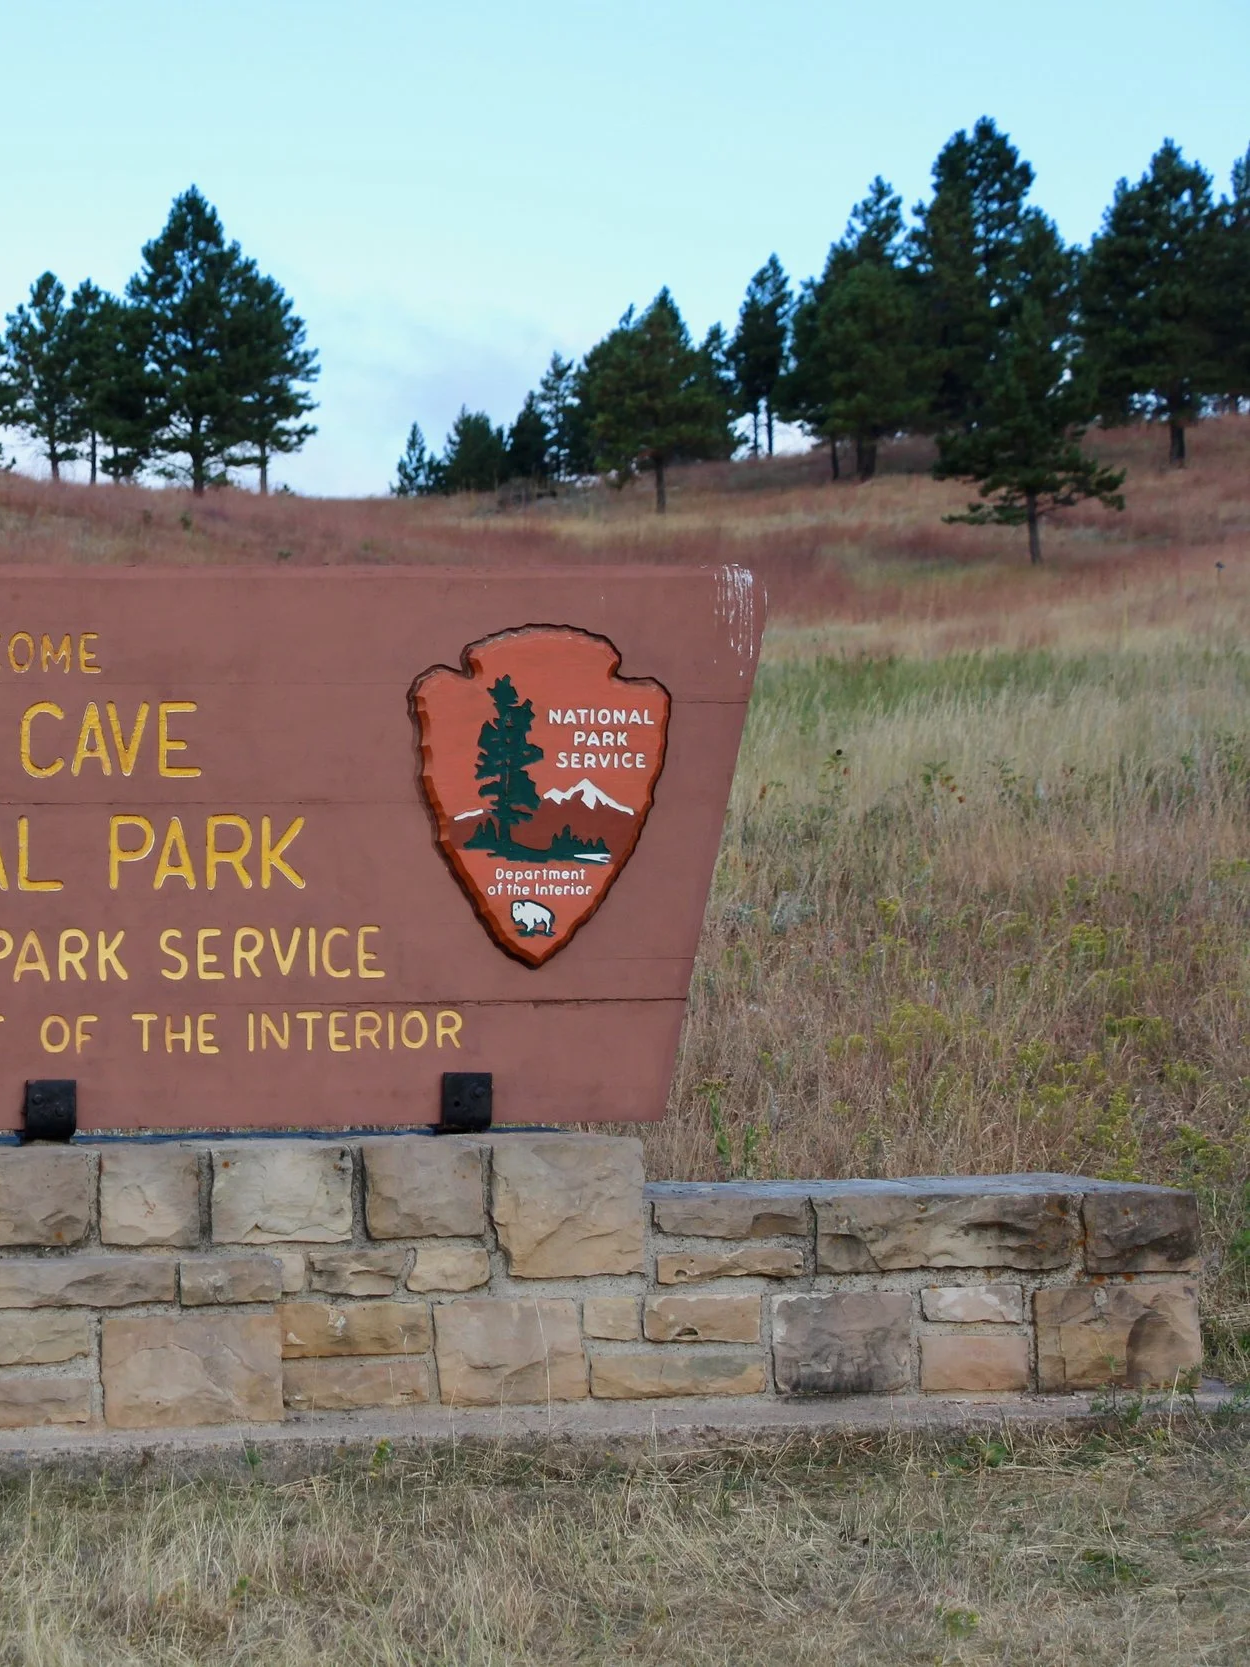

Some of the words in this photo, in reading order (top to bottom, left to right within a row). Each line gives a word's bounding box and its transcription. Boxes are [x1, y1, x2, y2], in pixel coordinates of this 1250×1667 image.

[548, 708, 655, 725] NATIONAL
[19, 700, 202, 778] CAVE
[573, 730, 628, 747] PARK
[555, 751, 646, 769] SERVICE
[108, 813, 306, 890] PARK
[495, 867, 586, 883] Department
[487, 883, 503, 896] of
[506, 883, 531, 896] the
[534, 882, 592, 896] Interior
[159, 924, 386, 981] SERVICE
[40, 1014, 99, 1056] OF
[132, 1012, 220, 1054] THE
[247, 1009, 463, 1052] INTERIOR
